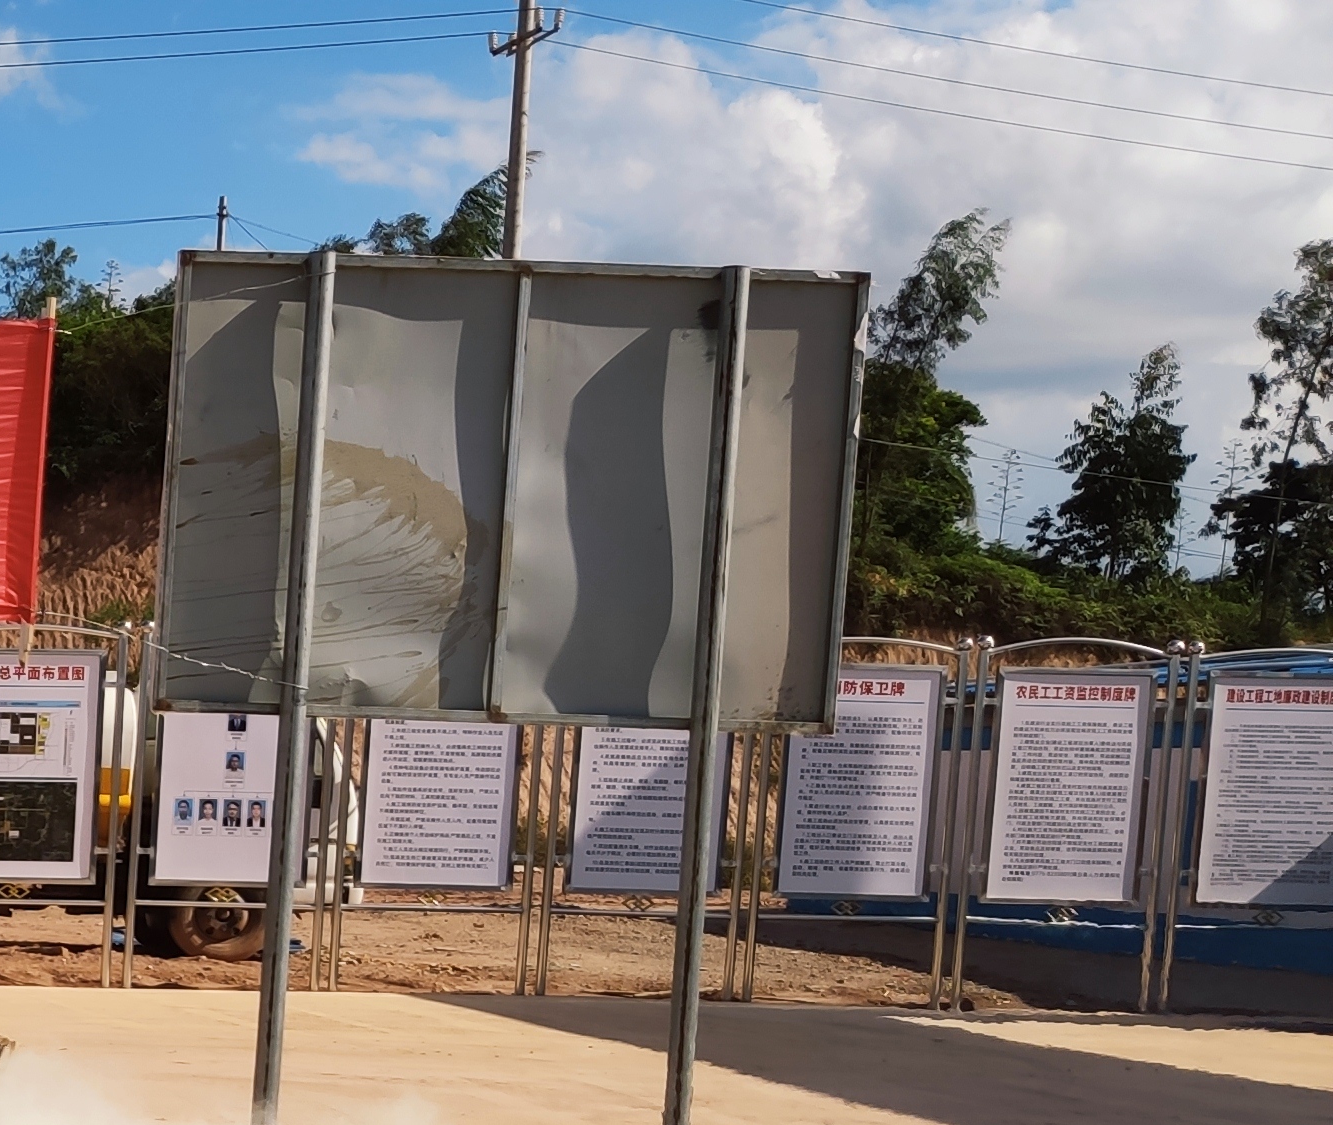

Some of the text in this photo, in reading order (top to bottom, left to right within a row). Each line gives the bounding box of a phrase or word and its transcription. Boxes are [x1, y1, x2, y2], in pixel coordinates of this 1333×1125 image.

[837, 680, 905, 697] 防保卫牌
[1016, 685, 1136, 702] 农民工工资监控制度牌
